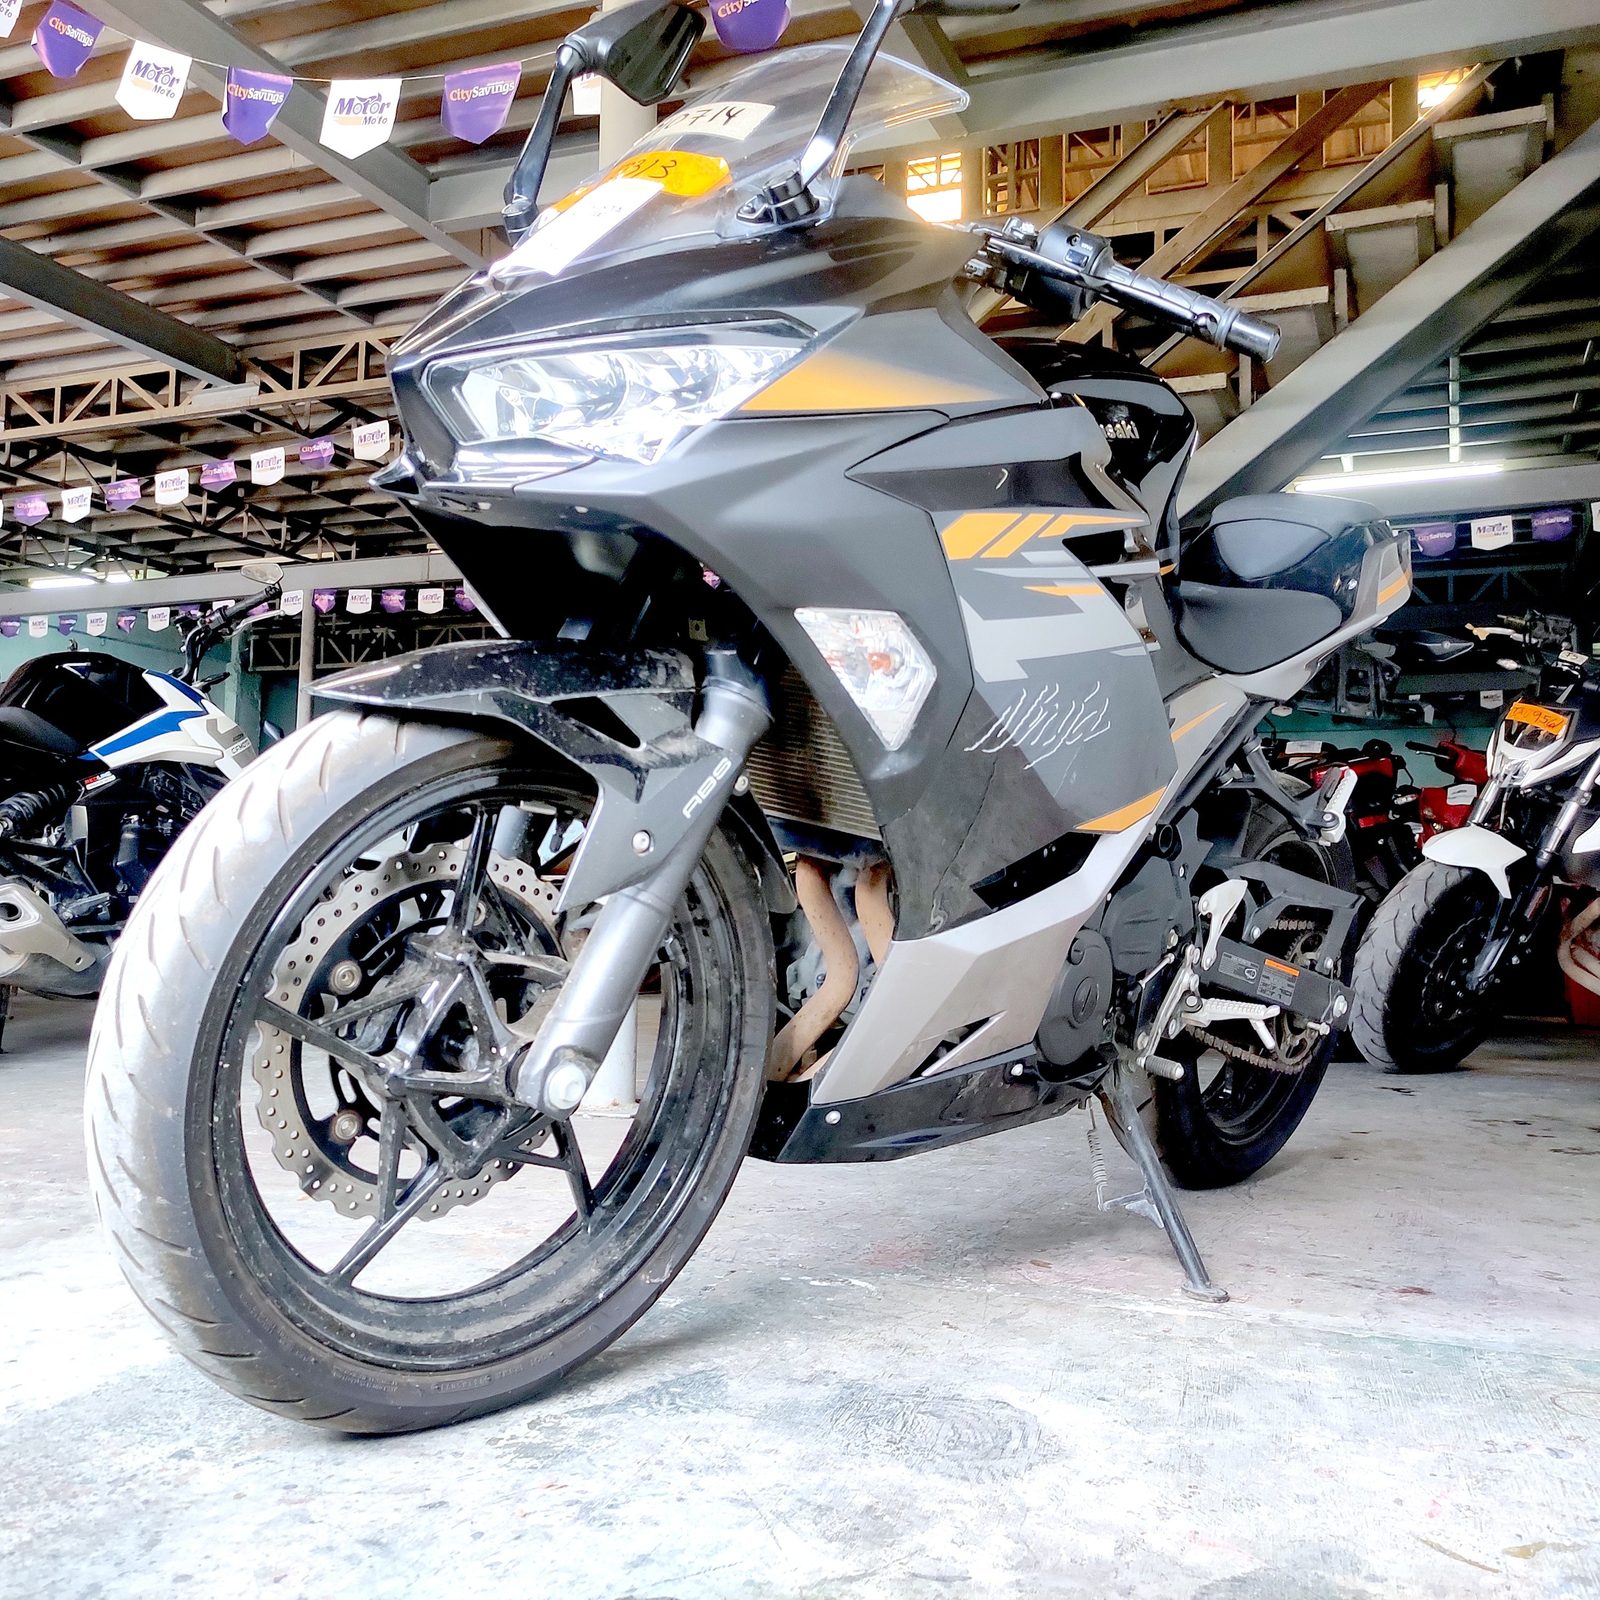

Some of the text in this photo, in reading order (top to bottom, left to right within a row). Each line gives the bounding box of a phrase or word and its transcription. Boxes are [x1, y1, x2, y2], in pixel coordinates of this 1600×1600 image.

[48, 16, 94, 47] CitySavings
[131, 60, 180, 88] Motor
[227, 83, 285, 105] CitySavings
[449, 80, 515, 103] CitySavings
[333, 92, 391, 115] Motor
[1099, 420, 1140, 439] saki
[682, 757, 732, 819] ABS
